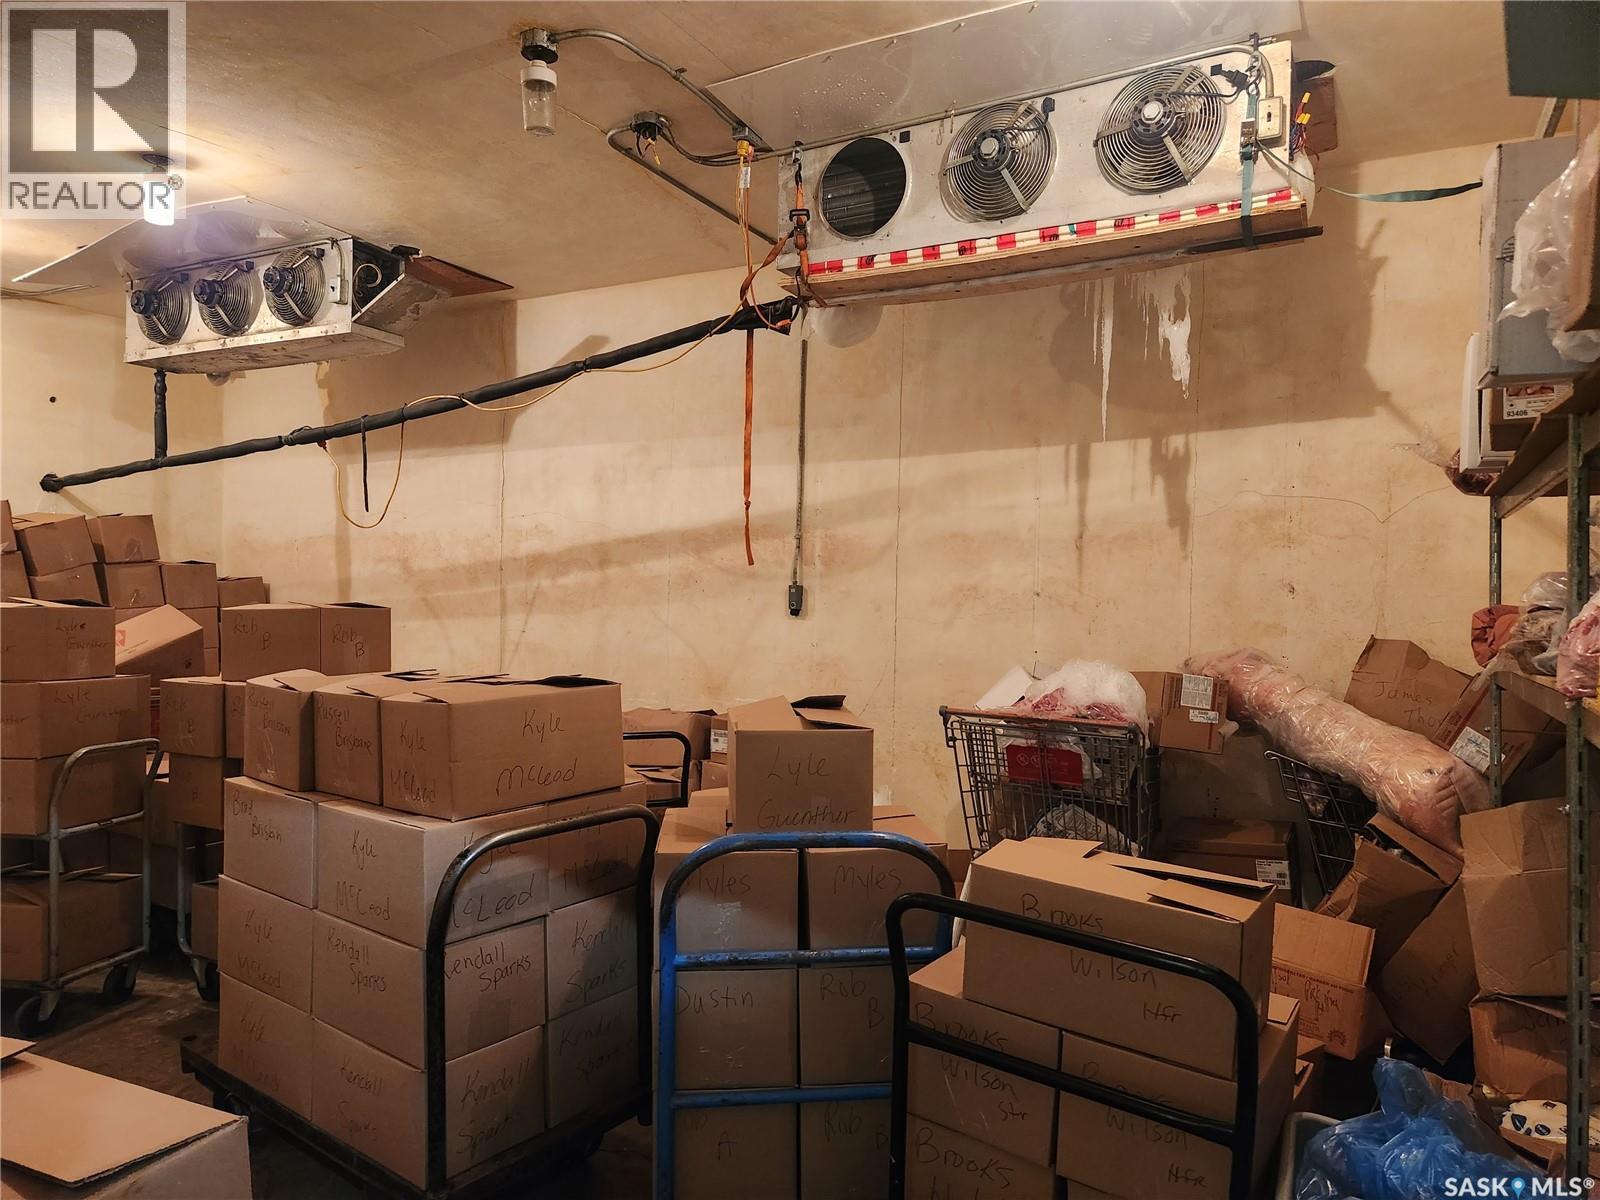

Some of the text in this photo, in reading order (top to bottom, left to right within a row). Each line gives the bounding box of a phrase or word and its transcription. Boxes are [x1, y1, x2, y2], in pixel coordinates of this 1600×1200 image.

[399, 721, 427, 753] Kyle
[520, 711, 564, 743] Kyle
[495, 758, 578, 798] McLeod
[767, 743, 831, 788] Lyle
[833, 863, 905, 897] Myles
[479, 955, 533, 993] Sparks
[819, 969, 867, 1001] Rob
[675, 983, 754, 1015] Dustin
[866, 995, 885, 1031] B
[914, 1127, 1015, 1189] Brooks
